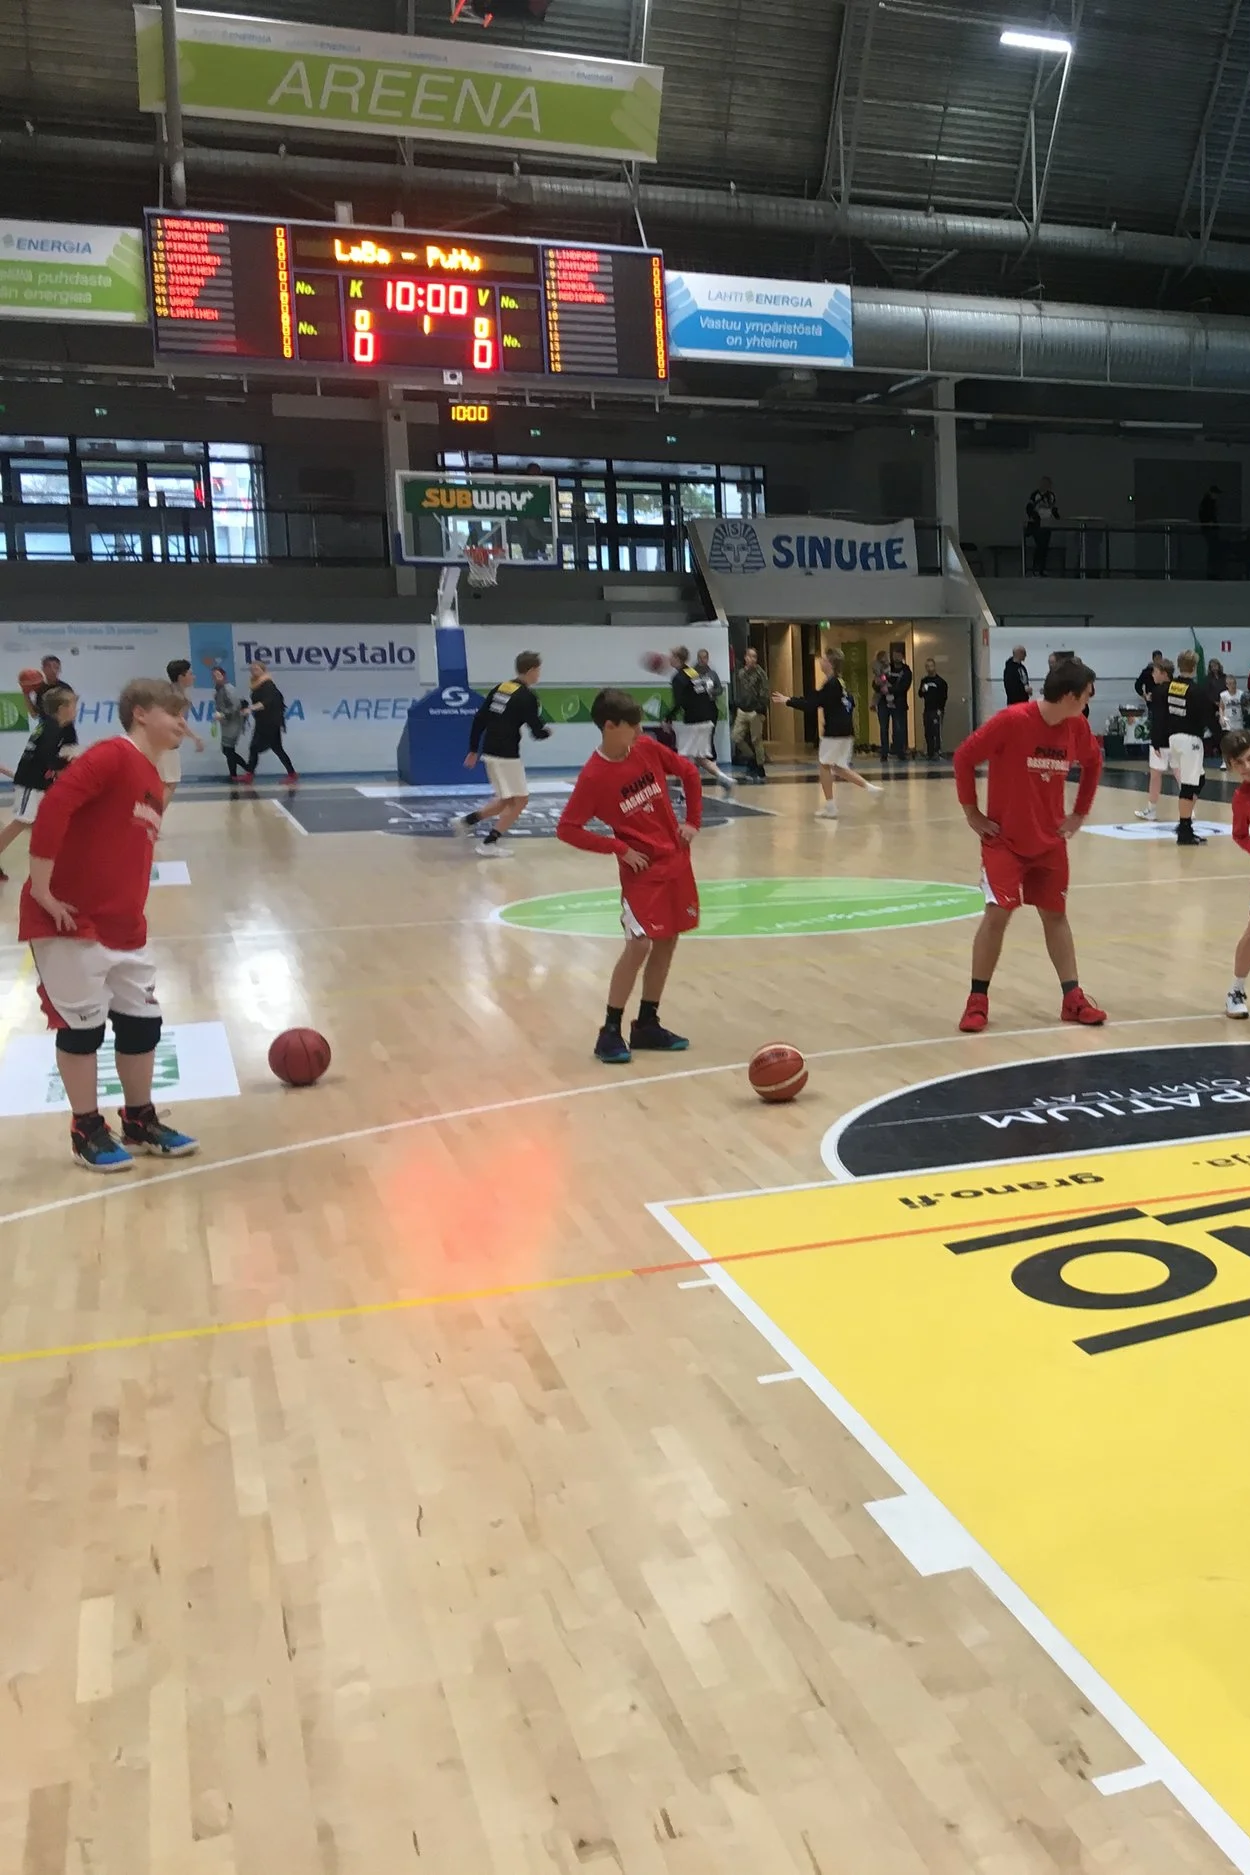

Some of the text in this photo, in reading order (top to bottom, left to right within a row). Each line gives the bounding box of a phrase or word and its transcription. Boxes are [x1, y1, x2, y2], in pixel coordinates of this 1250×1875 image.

[267, 60, 541, 133] AREENA
[16, 237, 92, 255] ENERGIA
[296, 282, 315, 295] No.
[350, 279, 364, 298] K
[386, 280, 468, 315] 10:00
[478, 289, 490, 307] V
[708, 290, 813, 308] LAHTI ENERGIA
[500, 296, 519, 309] No.
[298, 322, 318, 335] No.
[355, 309, 370, 331] 0
[474, 317, 489, 339] 0
[700, 316, 823, 337] Vastuu ympäristöstä
[354, 331, 374, 363] 0
[503, 334, 521, 348] No.
[727, 336, 798, 350] on yhteinen
[473, 339, 492, 369] 0
[422, 487, 533, 511] SUBWAY
[772, 534, 907, 571] SINUHE
[237, 641, 416, 670] Terveystalo
[898, 1172, 1105, 1209] grano.fi
